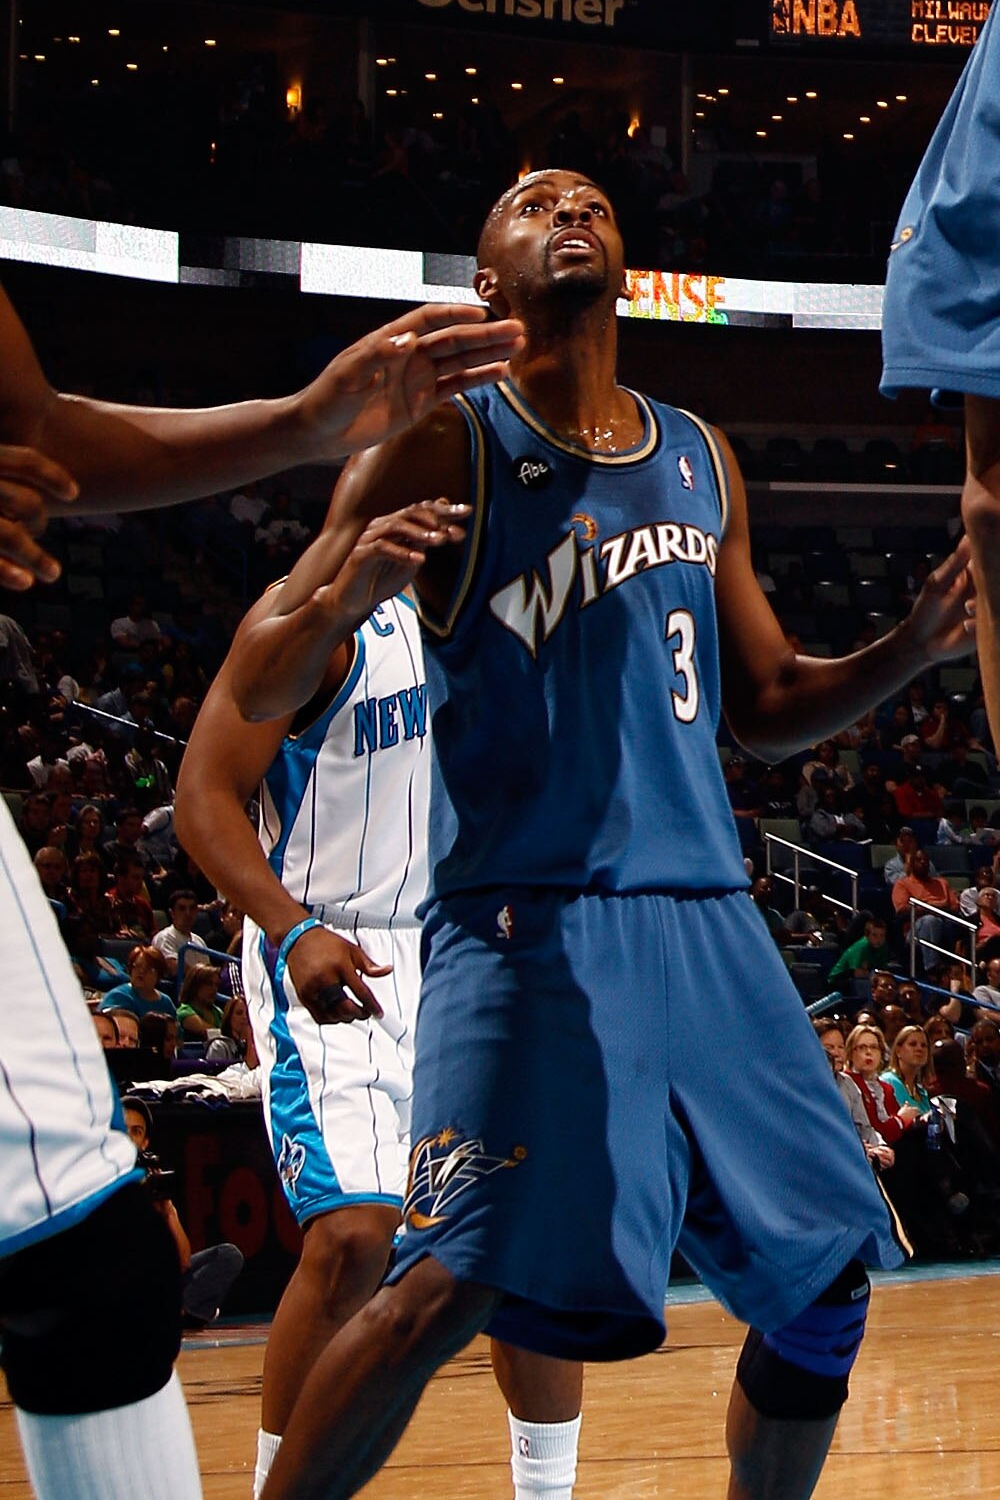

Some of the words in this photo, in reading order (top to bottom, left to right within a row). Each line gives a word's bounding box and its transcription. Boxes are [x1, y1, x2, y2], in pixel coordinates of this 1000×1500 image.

[516, 461, 549, 485] Abe
[665, 608, 699, 723] 3
[353, 684, 427, 758] NEW
